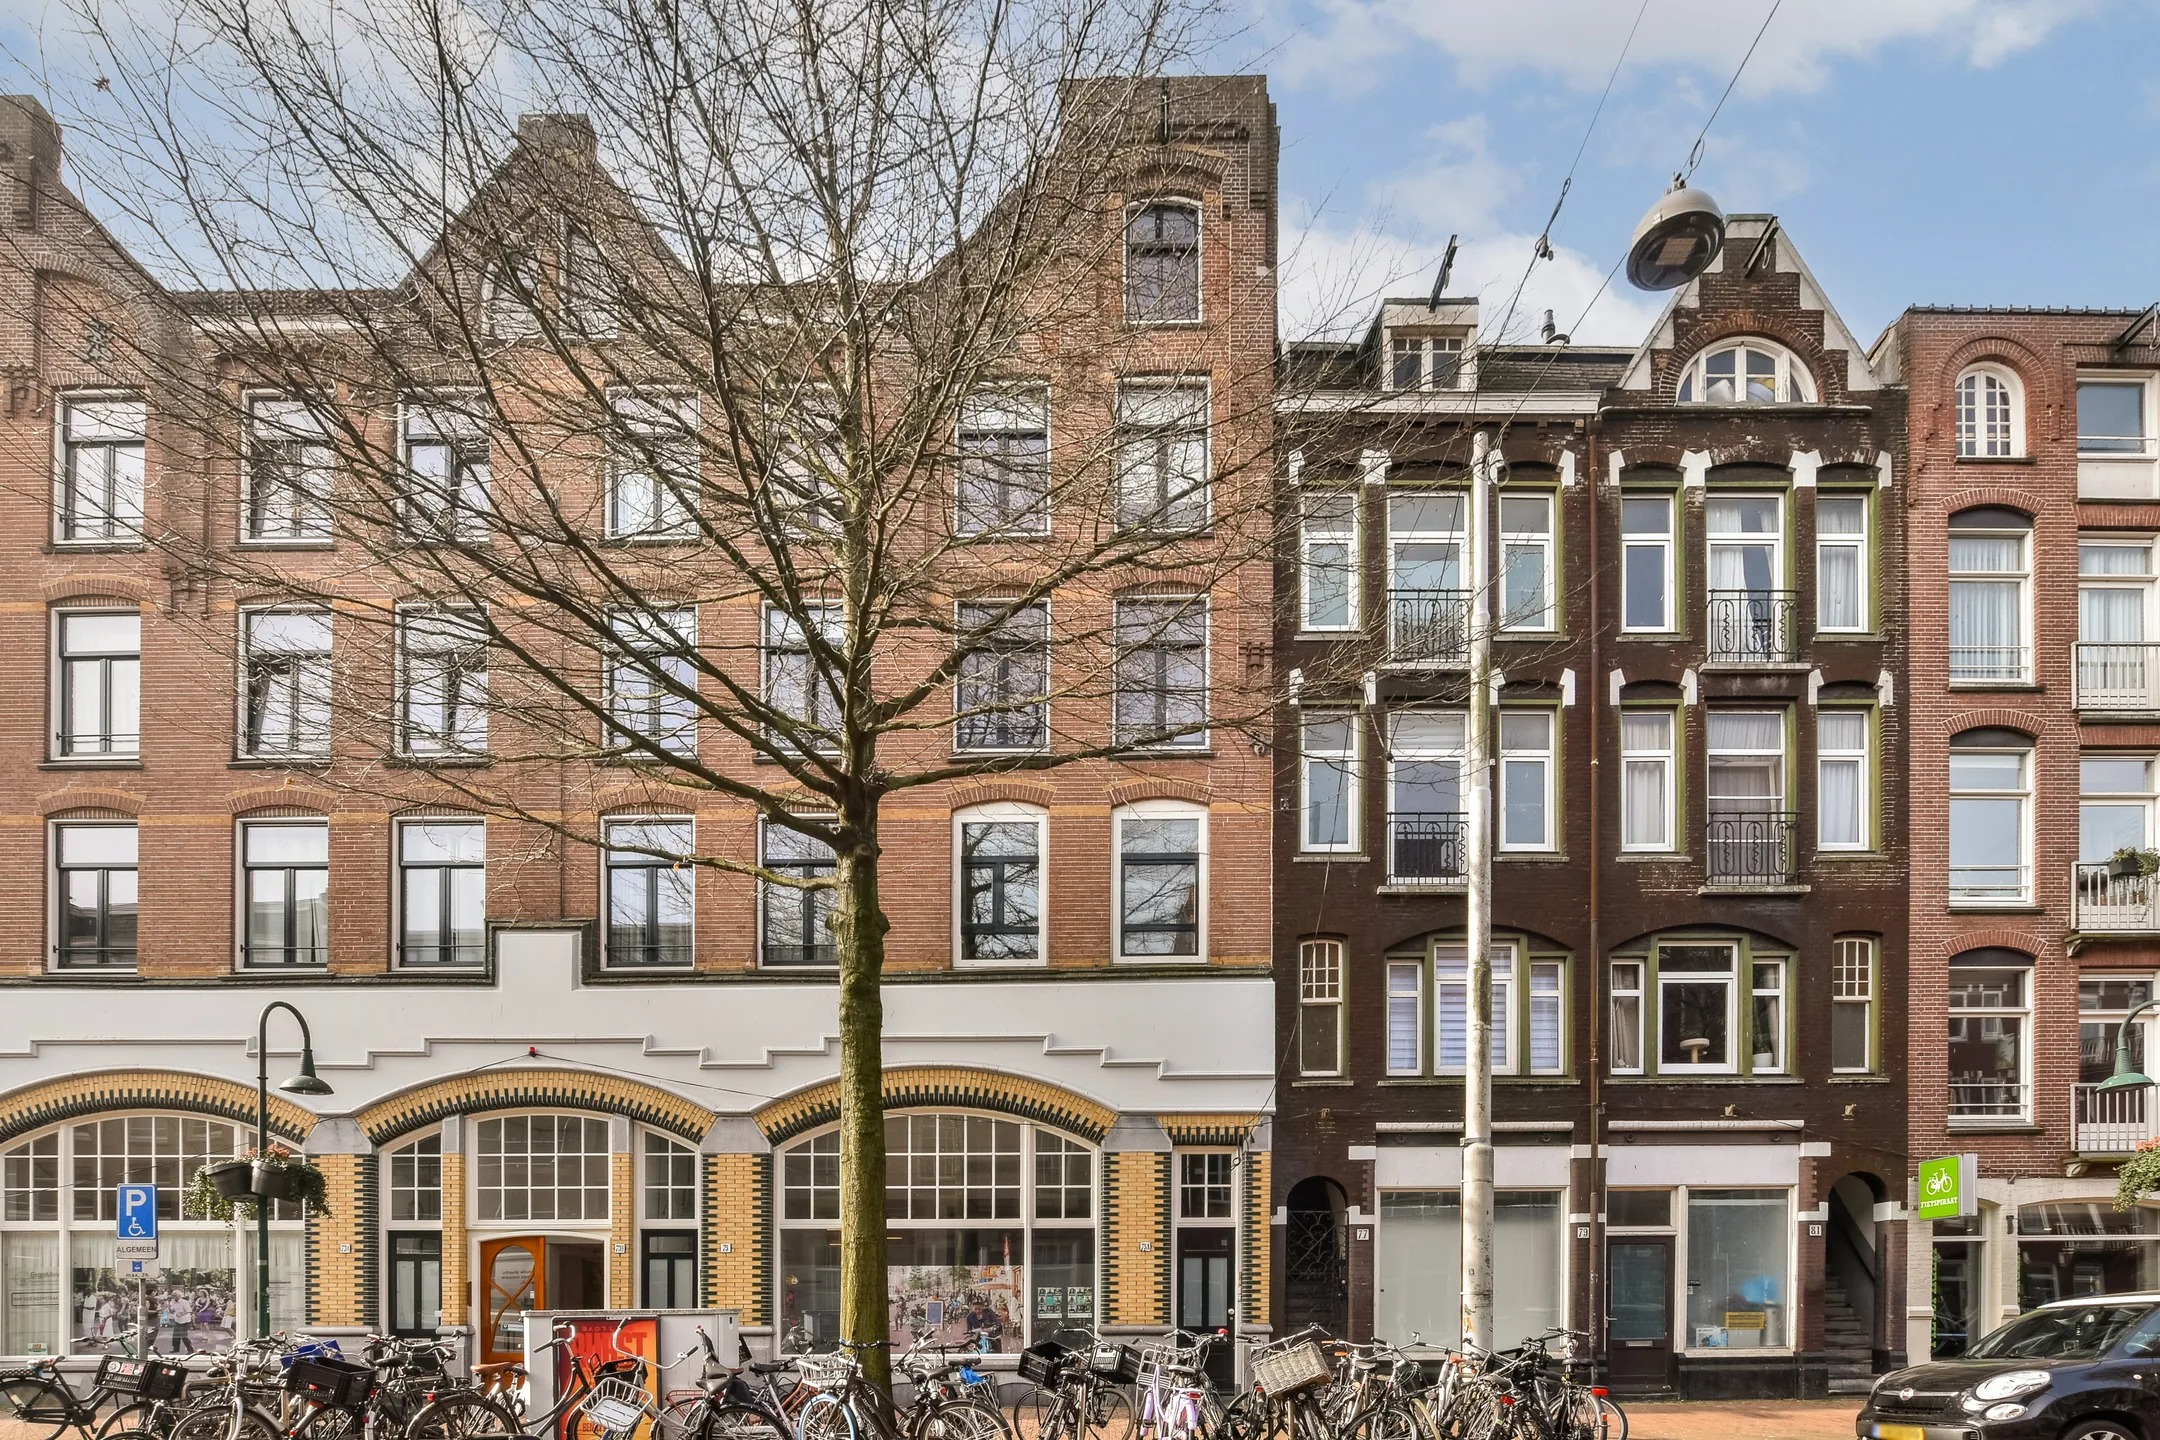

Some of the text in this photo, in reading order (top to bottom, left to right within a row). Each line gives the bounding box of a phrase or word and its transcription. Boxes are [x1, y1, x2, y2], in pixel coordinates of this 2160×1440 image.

[126, 1189, 146, 1216] P
[1920, 1197, 1958, 1208] FIETSPIRAAT
[1358, 1229, 1368, 1239] 77
[1578, 1228, 1588, 1237] 79
[1810, 1225, 1820, 1235] 81
